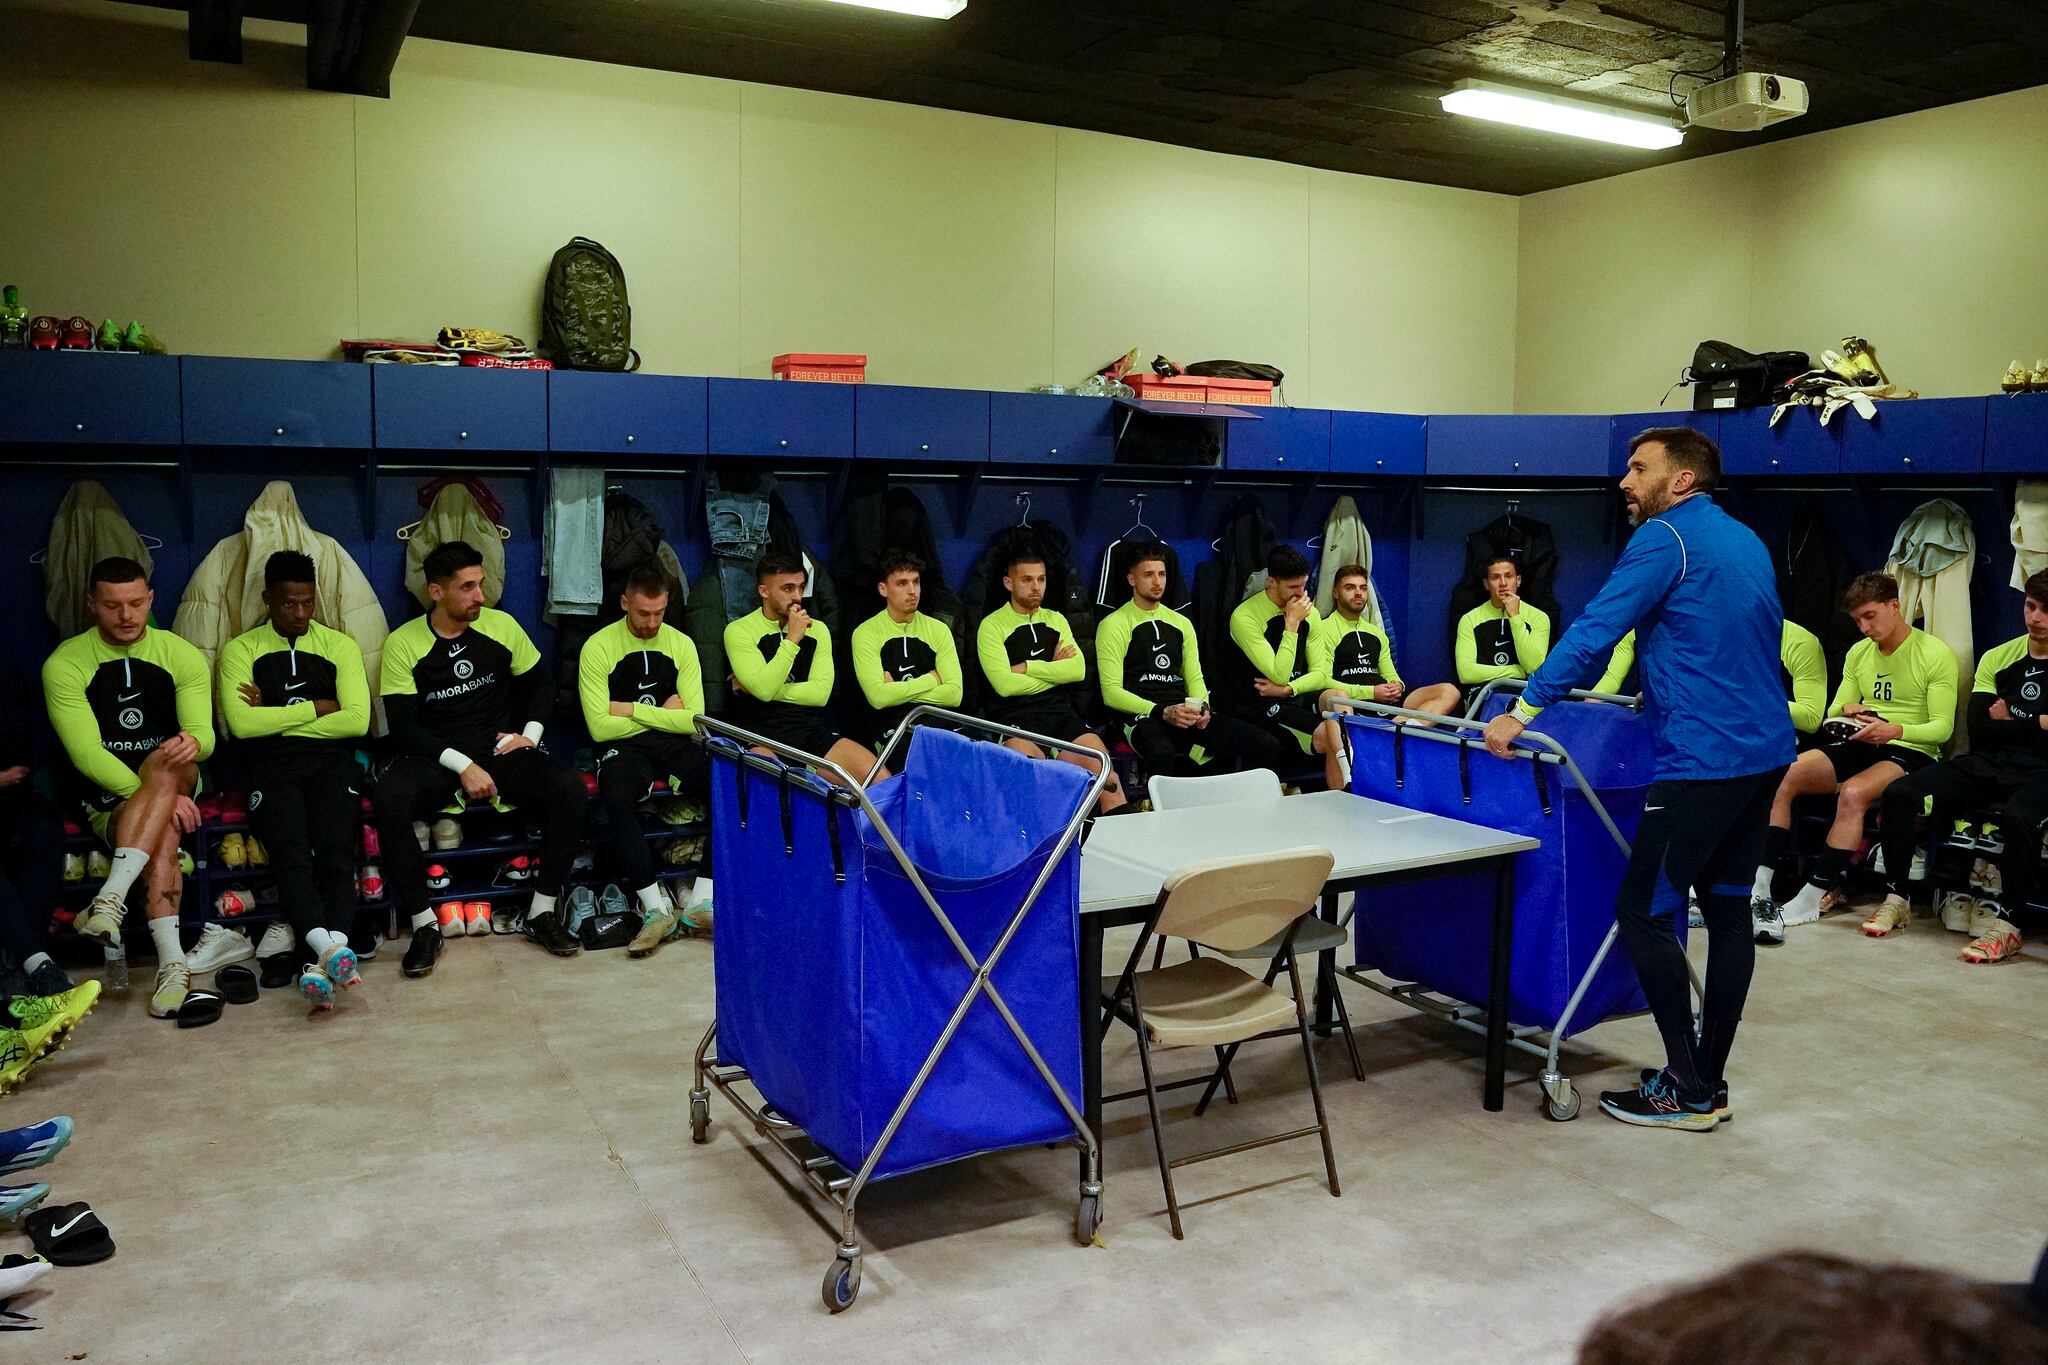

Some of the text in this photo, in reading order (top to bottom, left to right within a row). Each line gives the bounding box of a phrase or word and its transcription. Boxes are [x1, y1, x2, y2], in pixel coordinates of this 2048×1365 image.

[790, 371, 864, 382] FOREVER BETTER
[1142, 391, 1206, 401] FOREVER BETTER
[1207, 393, 1270, 403] FOREVER BETTER
[436, 673, 495, 699] MORABANC
[1873, 682, 1892, 701] 26
